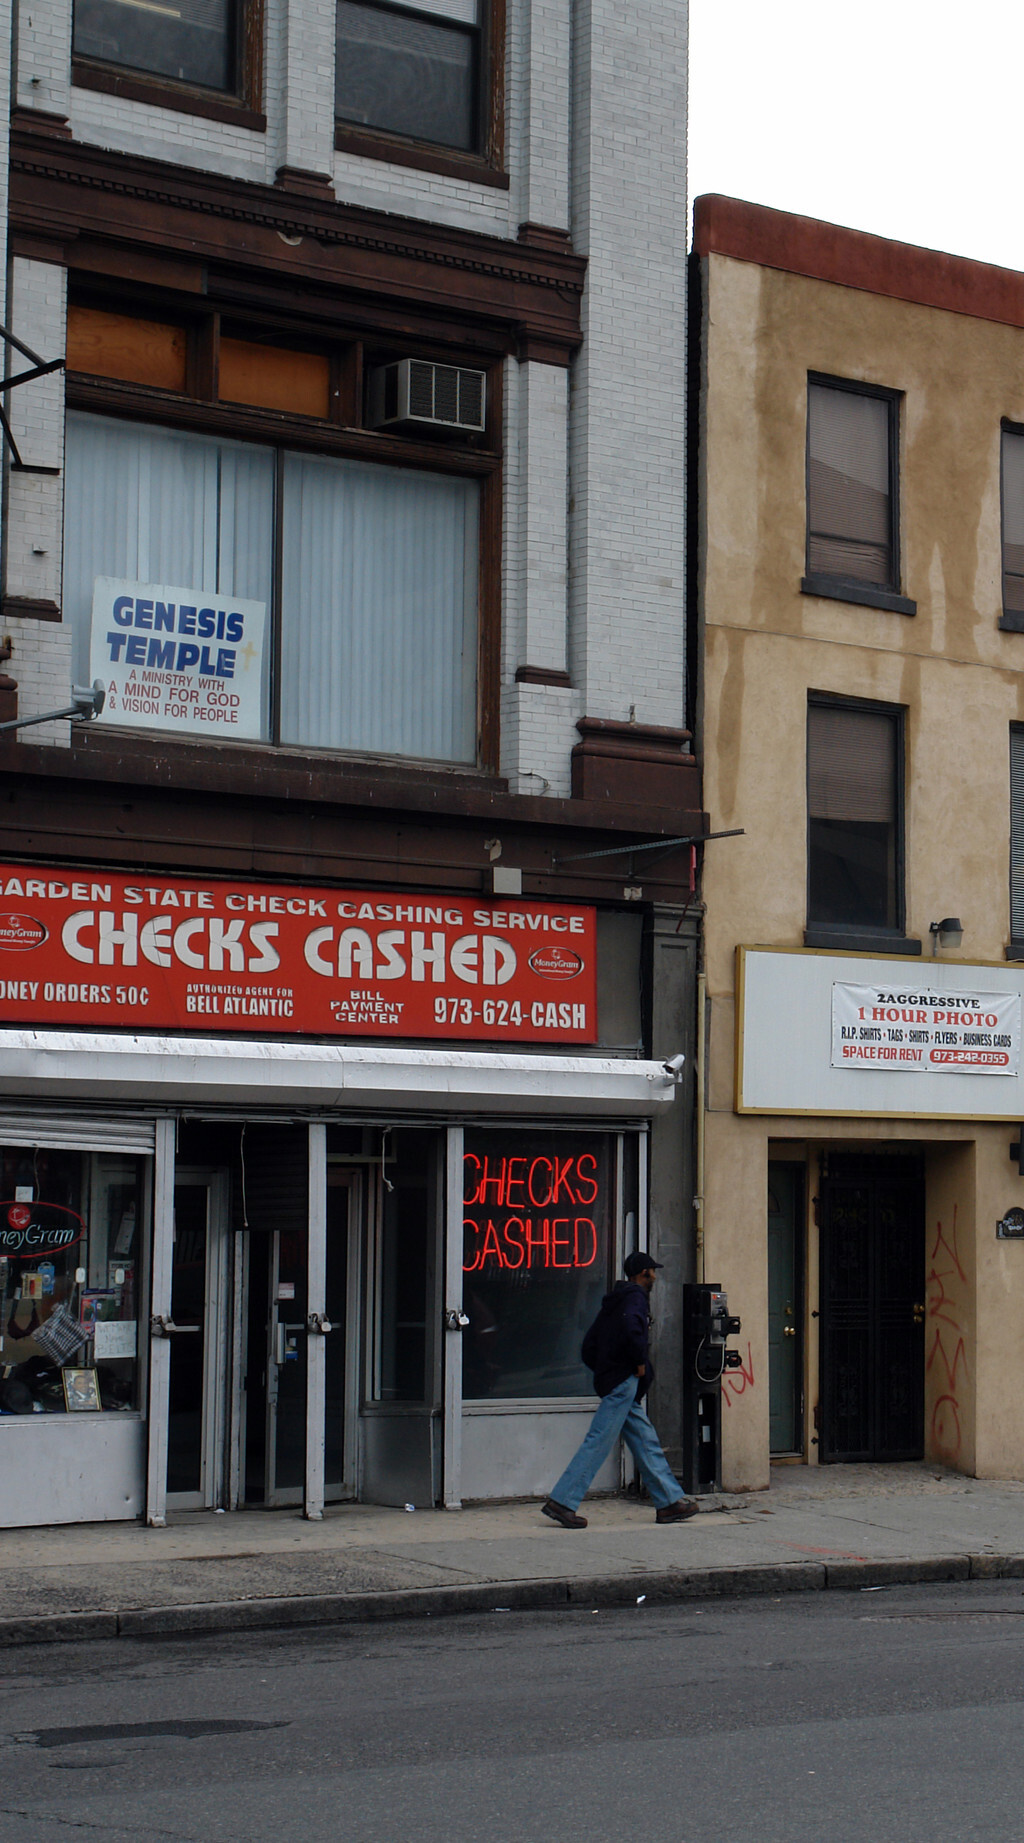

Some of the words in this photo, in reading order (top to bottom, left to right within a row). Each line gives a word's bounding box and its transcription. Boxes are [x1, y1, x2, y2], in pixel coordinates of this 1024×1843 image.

[113, 596, 244, 642] GENESIS
[106, 632, 236, 679] TEMPLE
[129, 669, 137, 681] A
[141, 671, 193, 687] MINISTRY
[198, 678, 225, 692] WITH
[108, 680, 117, 694] A
[124, 683, 161, 699] MIND
[169, 687, 199, 703] FOR
[206, 692, 240, 707] GOD
[109, 696, 116, 710] &
[122, 698, 159, 715] VISION
[164, 704, 187, 719] FOR
[193, 707, 238, 723] PEOPLE
[123, 886, 215, 909] STATE
[225, 894, 327, 917] CHECK
[337, 901, 463, 926] CASHING
[473, 909, 585, 934] SERVICE
[61, 910, 281, 973] CHECKS
[304, 926, 517, 986] CASHED
[534, 958, 579, 969] MoneyGram
[44, 982, 111, 1004] ORDERS
[187, 983, 243, 996] AUTHORIZED
[245, 987, 274, 997] AGENT
[276, 988, 293, 998] FOR
[350, 990, 385, 1001] BILL
[877, 993, 980, 1009] 2AGGRESSIVE
[187, 995, 220, 1014] BELL
[223, 997, 294, 1018] ATLANTIC
[330, 1001, 404, 1014] PAYMENT
[434, 997, 586, 1029] 973-624-CASH
[857, 1007, 866, 1020] 1
[872, 1007, 928, 1024] HOUR
[933, 1011, 998, 1027] PHOTO
[335, 1012, 399, 1025] CENTER
[841, 1026, 858, 1040] R.I.P.
[859, 1027, 882, 1041] SHIRTS
[887, 1028, 903, 1042] TAGS
[908, 1030, 929, 1044] SHIRTS
[934, 1031, 957, 1045] FLYERS
[963, 1032, 992, 1047] BUSINESS
[993, 1034, 1011, 1048] CARDS
[842, 1045, 876, 1059] SPACE
[877, 1047, 897, 1060] FOR
[899, 1048, 923, 1061] RENT
[933, 1051, 1006, 1064] 973-242-0355
[463, 1153, 598, 1208] CHECKS
[463, 1217, 597, 1271] CASHED
